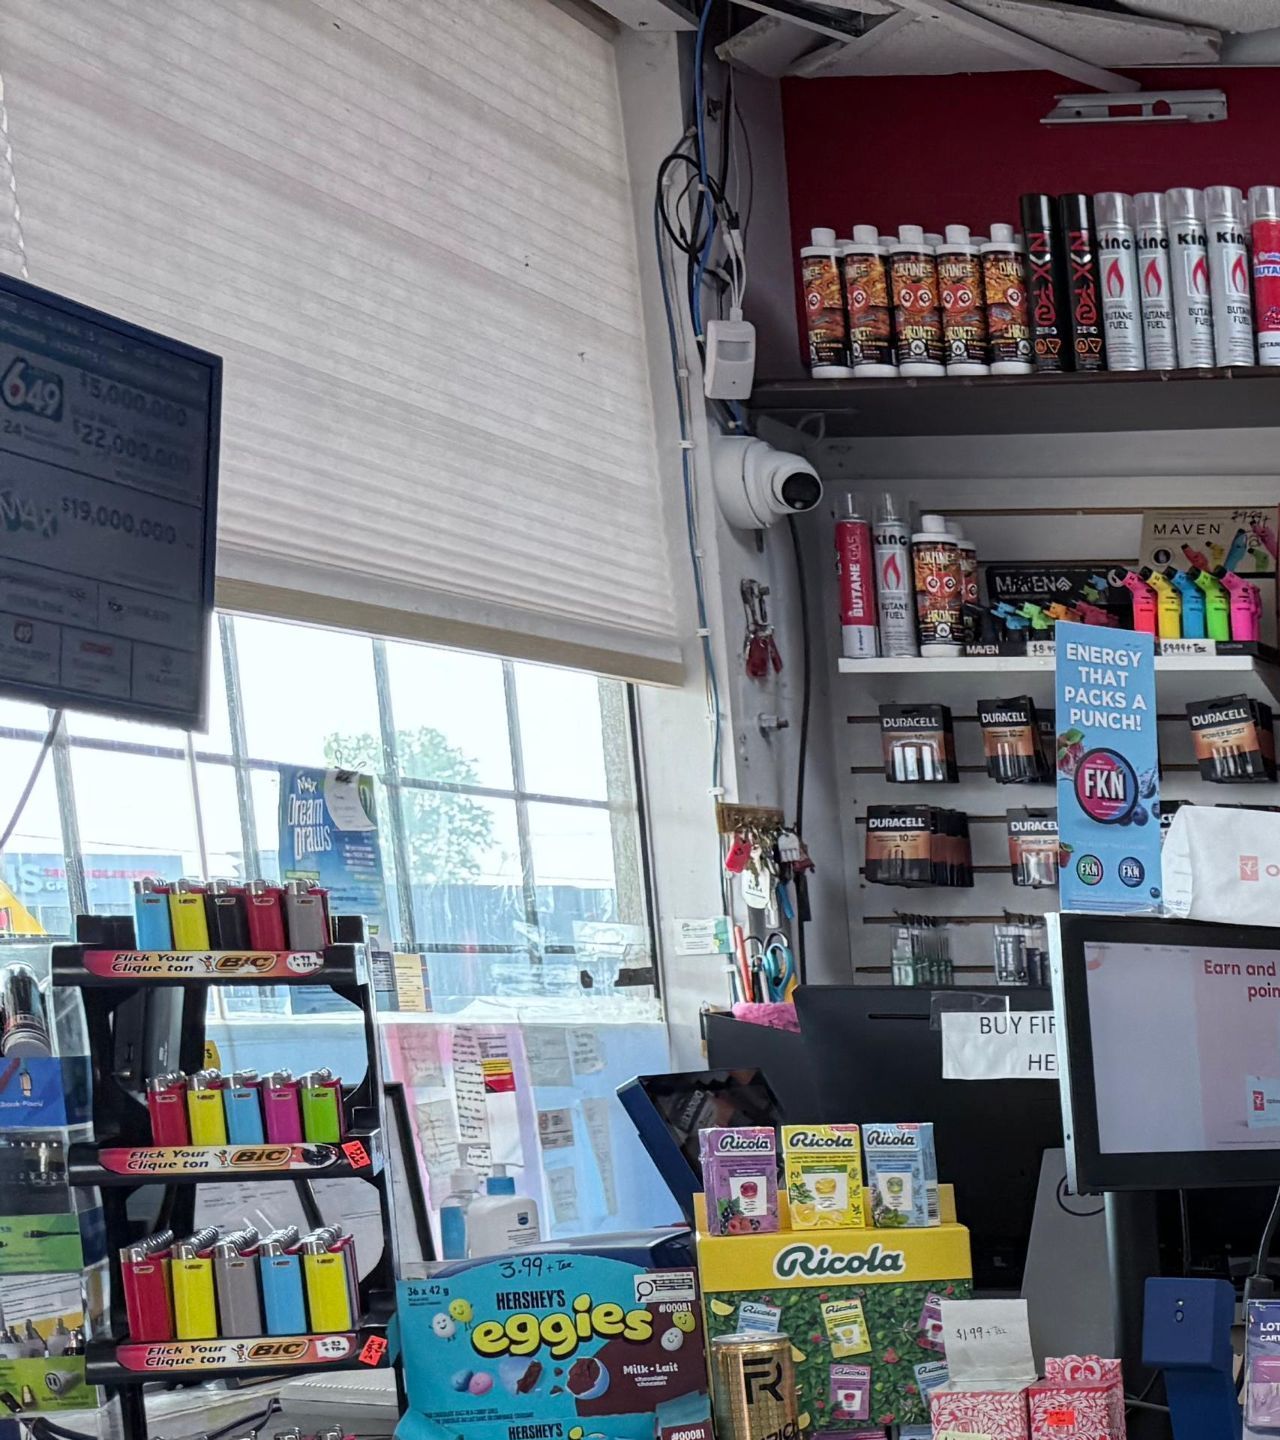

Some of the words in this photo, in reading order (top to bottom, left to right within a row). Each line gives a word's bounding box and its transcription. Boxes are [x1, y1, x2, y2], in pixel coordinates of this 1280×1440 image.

[1153, 522, 1222, 535] MAVEN
[1066, 643, 1142, 668] ENERGY
[1078, 667, 1129, 687] THAT
[1064, 687, 1126, 709] PACKS
[1131, 695, 1147, 710] A
[882, 716, 938, 728] DURACELL
[1069, 708, 1142, 731] PUNCH!
[1084, 769, 1124, 800] FKN
[1204, 960, 1241, 977] Earn
[1246, 962, 1276, 978] and
[980, 1016, 1022, 1035] BUY
[790, 1132, 854, 1149] Ricola
[130, 1149, 169, 1160] Flick
[173, 1150, 209, 1159] Your
[235, 1149, 287, 1162] BIC
[127, 1160, 179, 1171] Clique
[182, 1160, 209, 1168] ton
[775, 1245, 903, 1278] Ricola
[408, 1286, 420, 1296] 36
[429, 1287, 442, 1296] 42
[496, 1290, 566, 1310] HERSHEY'S
[659, 1303, 692, 1313] #00081
[472, 1294, 653, 1358] eggies
[623, 1363, 648, 1375] Milk
[656, 1362, 678, 1374] Lait
